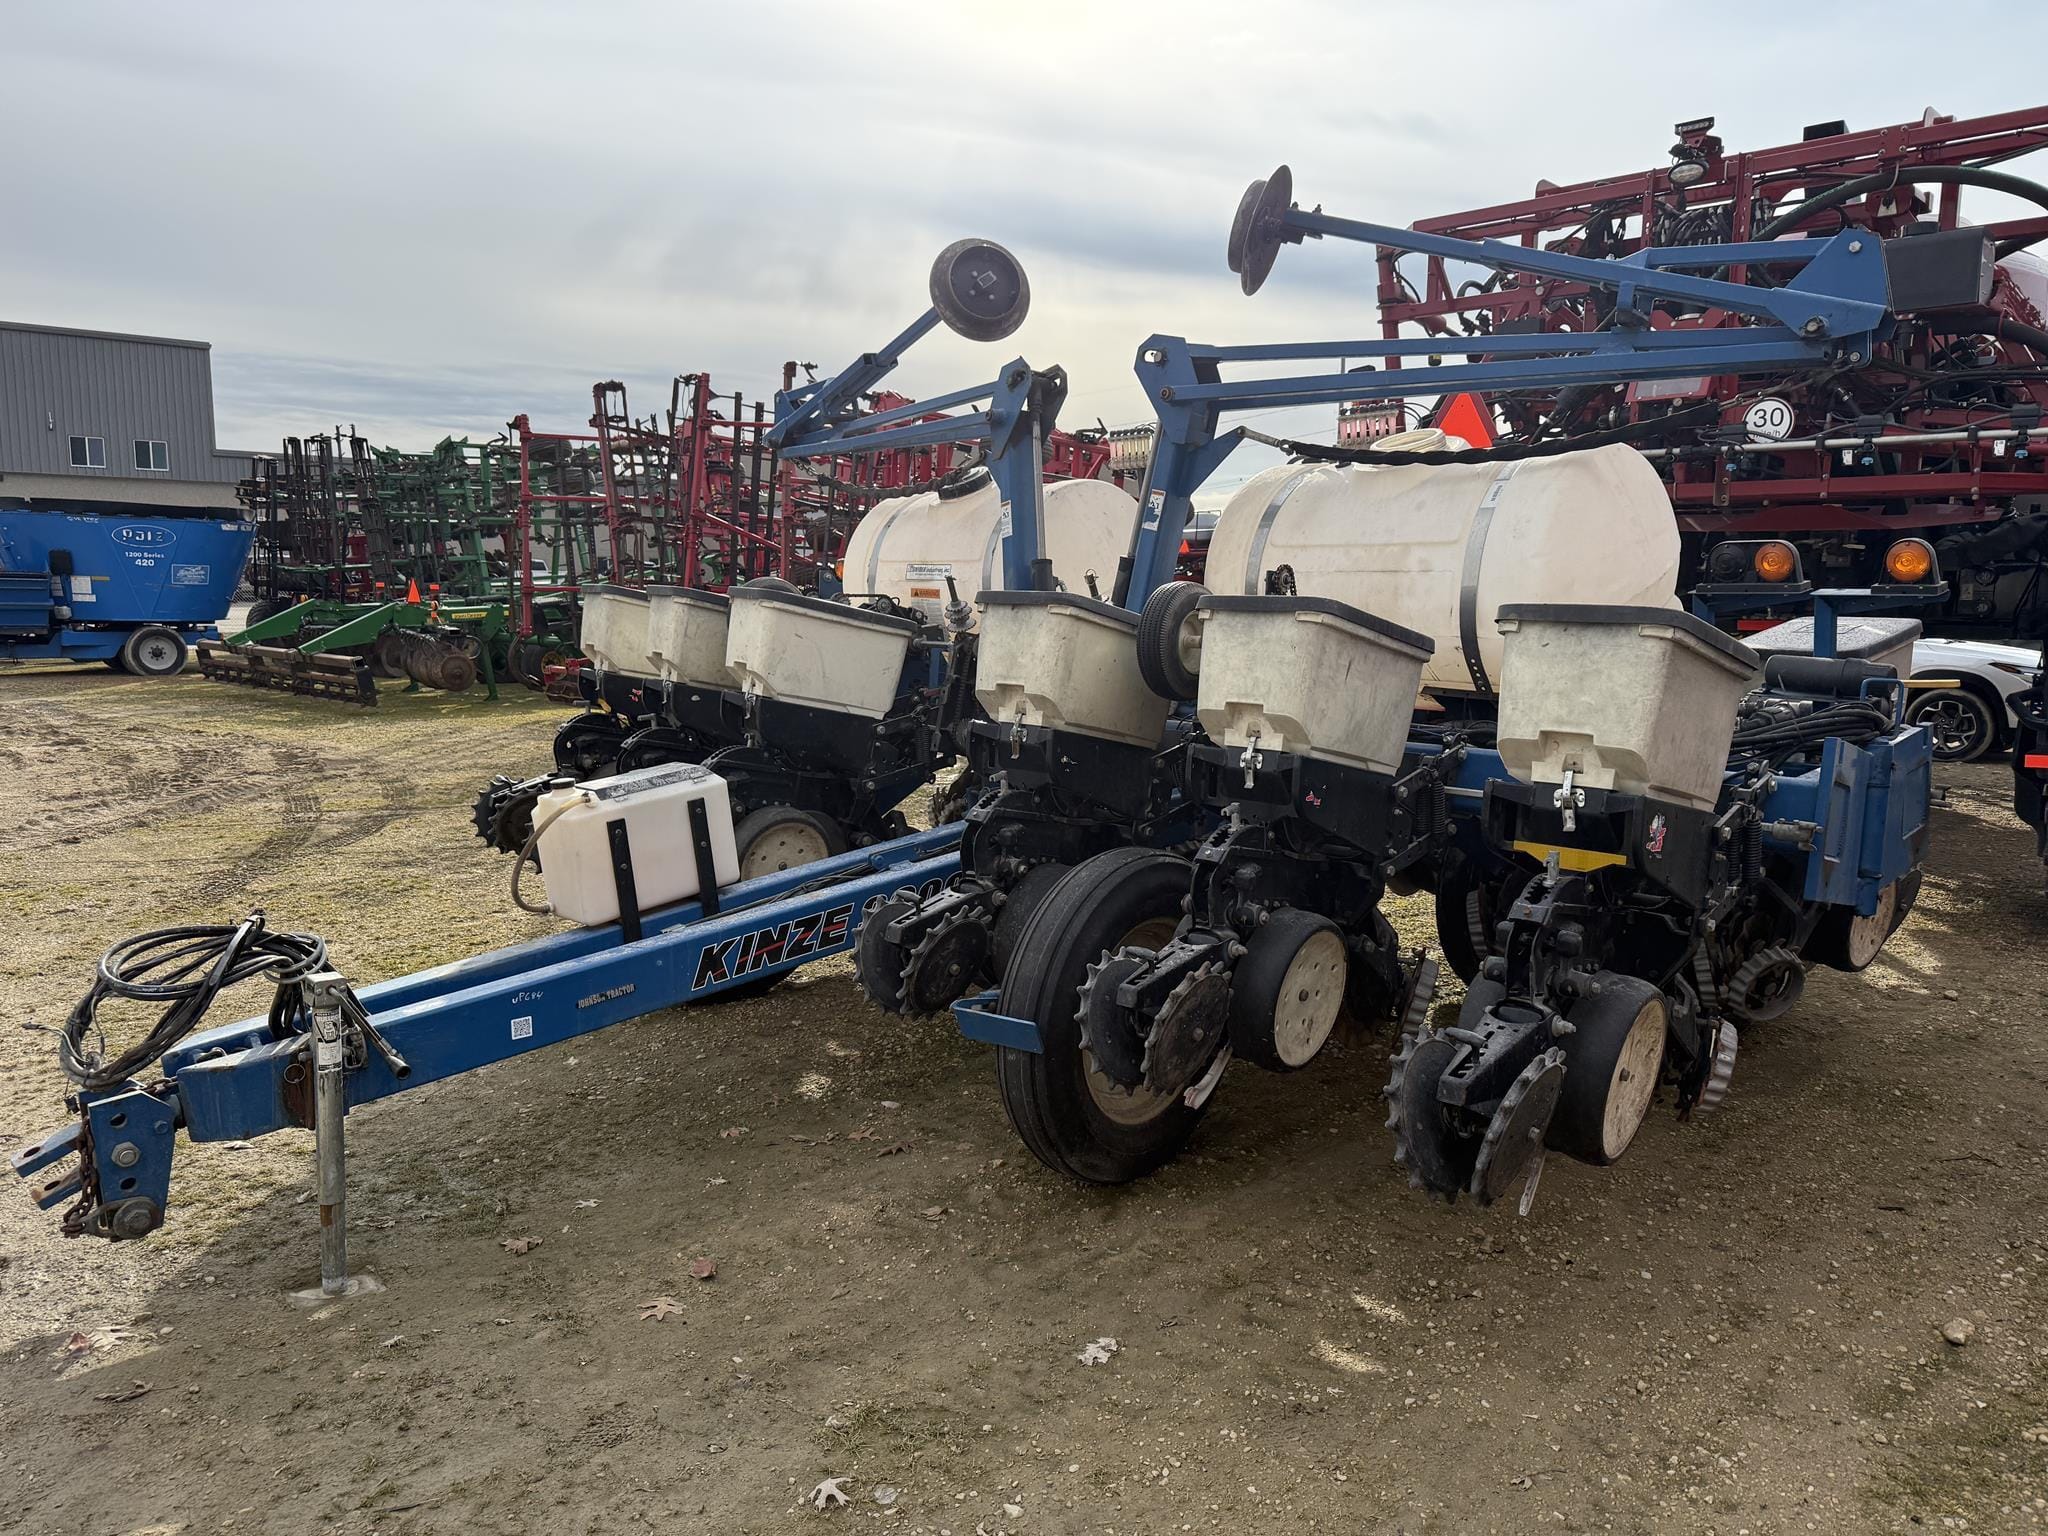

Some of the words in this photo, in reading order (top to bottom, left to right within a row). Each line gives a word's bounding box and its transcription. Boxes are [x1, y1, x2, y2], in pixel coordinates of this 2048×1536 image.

[1753, 407, 1784, 428] 30
[135, 559, 155, 567] 420
[691, 902, 855, 991] KINZE
[606, 983, 635, 1000] TRACTOR
